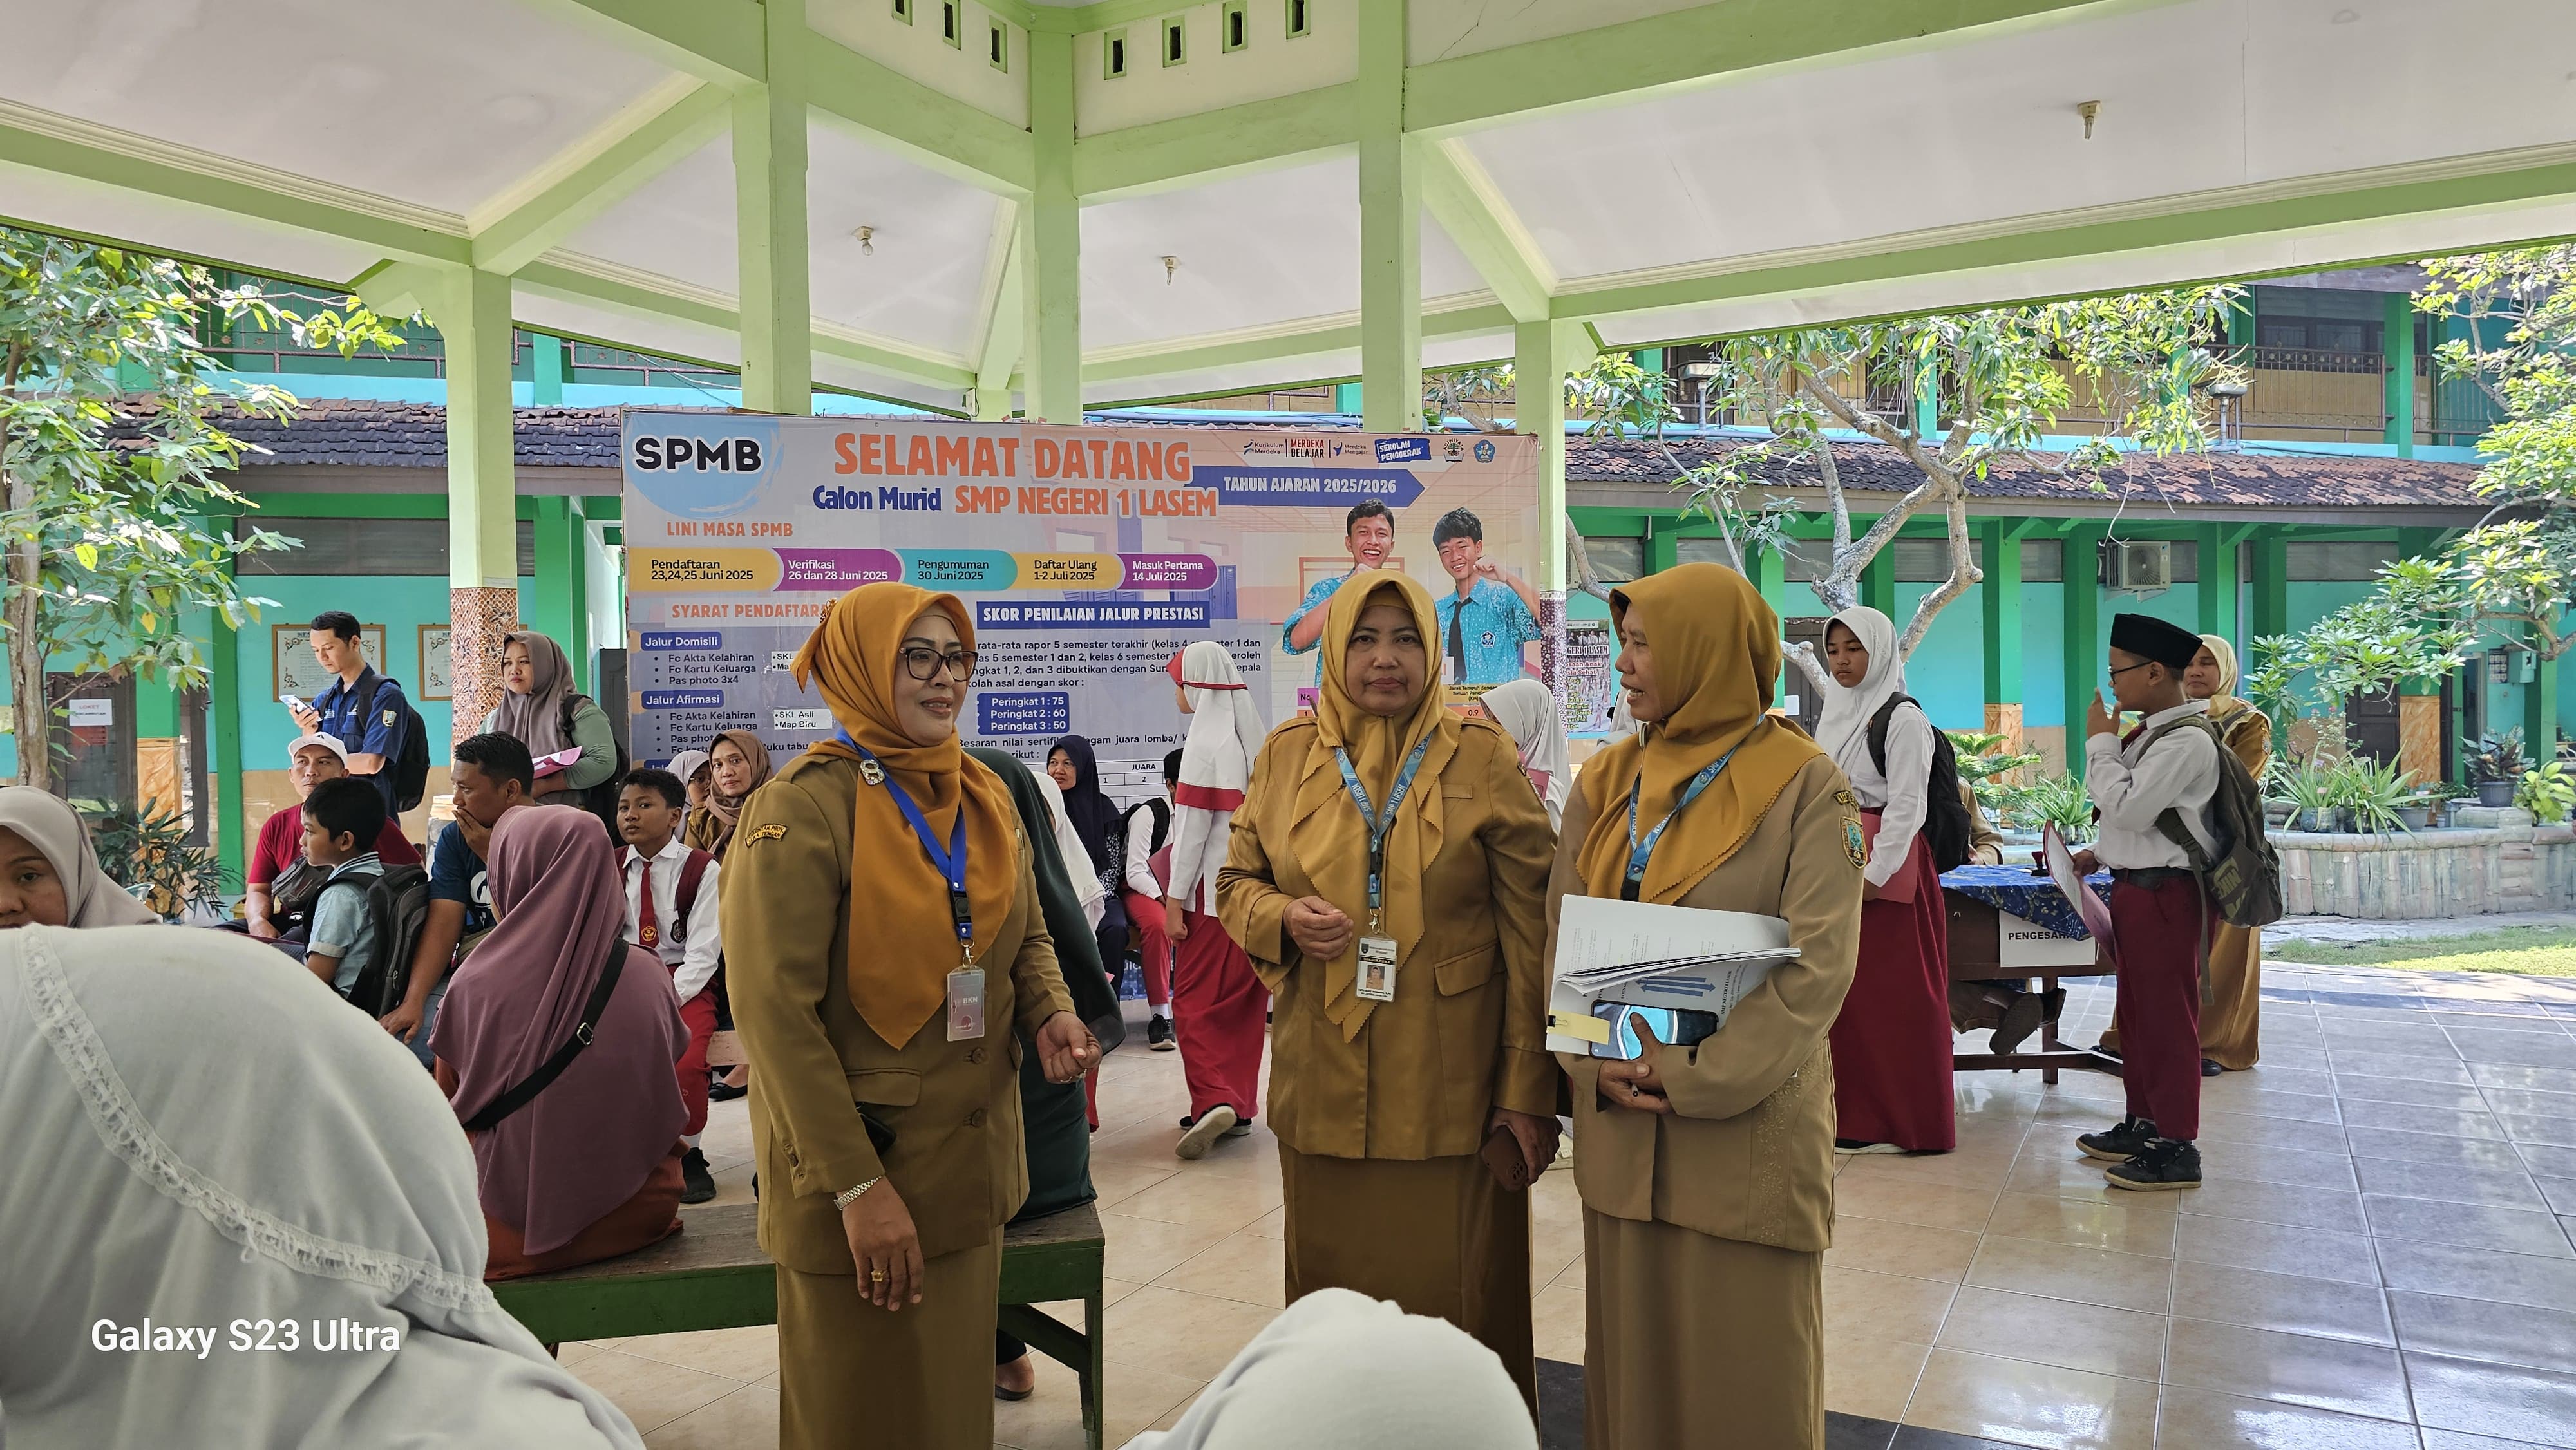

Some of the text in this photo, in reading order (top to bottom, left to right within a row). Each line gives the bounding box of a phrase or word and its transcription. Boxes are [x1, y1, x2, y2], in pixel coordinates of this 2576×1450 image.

[1291, 439, 1324, 448] MERDEKA
[1379, 440, 1411, 453] SEKOLAH
[1443, 438, 1464, 451] ADIWIYATA
[635, 437, 761, 471] SPMB
[834, 433, 1190, 481] SELAMAT DATANG
[1291, 449, 1324, 458] BELAJAR
[1381, 447, 1422, 462] PENGGERAK
[1224, 476, 1397, 493] TAHUN AJARAN 2025/2026
[813, 485, 1217, 516] Calon Murid SMP NEGERI 1 LASEM
[667, 522, 793, 536] LINI MASA SPMB
[651, 559, 720, 569] Pendaftaran
[788, 560, 835, 570] Verifikasi
[918, 560, 989, 572] Pengumuman
[1034, 560, 1097, 572] Daftar Ulang
[1133, 560, 1204, 570] Masuk Pertama
[651, 569, 753, 581] 23,24,25 Juni 2025
[788, 570, 888, 581] 26 dan 28 Juni 2025
[918, 570, 983, 581] 30 Juni 2025
[1034, 570, 1095, 581] 1-2 Juli 2025
[1133, 571, 1187, 581] 14 Juli 2025
[672, 605, 729, 618] SYARAT
[983, 607, 1204, 621] SKOR PENILAIAN JALUR PRESTASI
[645, 637, 718, 646] Jalur Domisili
[978, 641, 1021, 650] rata-rata
[1024, 642, 1051, 650] rapor
[1054, 641, 1060, 649] 5
[1063, 641, 1108, 649] semester
[1112, 640, 1148, 648] terakhir
[1151, 639, 1179, 649] (kelas
[1182, 639, 1188, 648] 4
[1567, 645, 1582, 655] GERI
[1589, 645, 1609, 655] LASEM
[668, 654, 681, 663] Fc
[708, 654, 754, 662] Kelahiran
[1001, 654, 1048, 662] semester
[1057, 653, 1075, 661] dan
[1078, 653, 1086, 663] 2,
[1126, 652, 1170, 660] semester
[713, 664, 757, 674] Keluarga
[973, 664, 1146, 676] ngkat 1, 2, dan 3 dibuktikan dengan
[1235, 663, 1261, 672] epala
[689, 676, 718, 686] photo
[1018, 679, 1055, 688] dengan
[1058, 678, 1079, 686] skor
[646, 694, 720, 705] Jalur Afirmasi
[992, 697, 1064, 708] Peringkat 1 75
[685, 712, 707, 720] Akta
[710, 711, 756, 720] Kelahiran
[990, 709, 1066, 720] Peringkat 2 60
[670, 722, 758, 732] Fc Kartu Keluarga
[991, 721, 1066, 732] Peringkat 3 50
[670, 734, 715, 745] Pas phot
[1002, 739, 1023, 747] nilai
[1115, 735, 1139, 745] juara
[1144, 733, 1177, 744] lomba/
[1351, 782, 1365, 799] LASEM
[1392, 784, 1406, 802] LASEM
[2008, 931, 2069, 940] PENGESAH
[963, 996, 978, 1004] BKN
